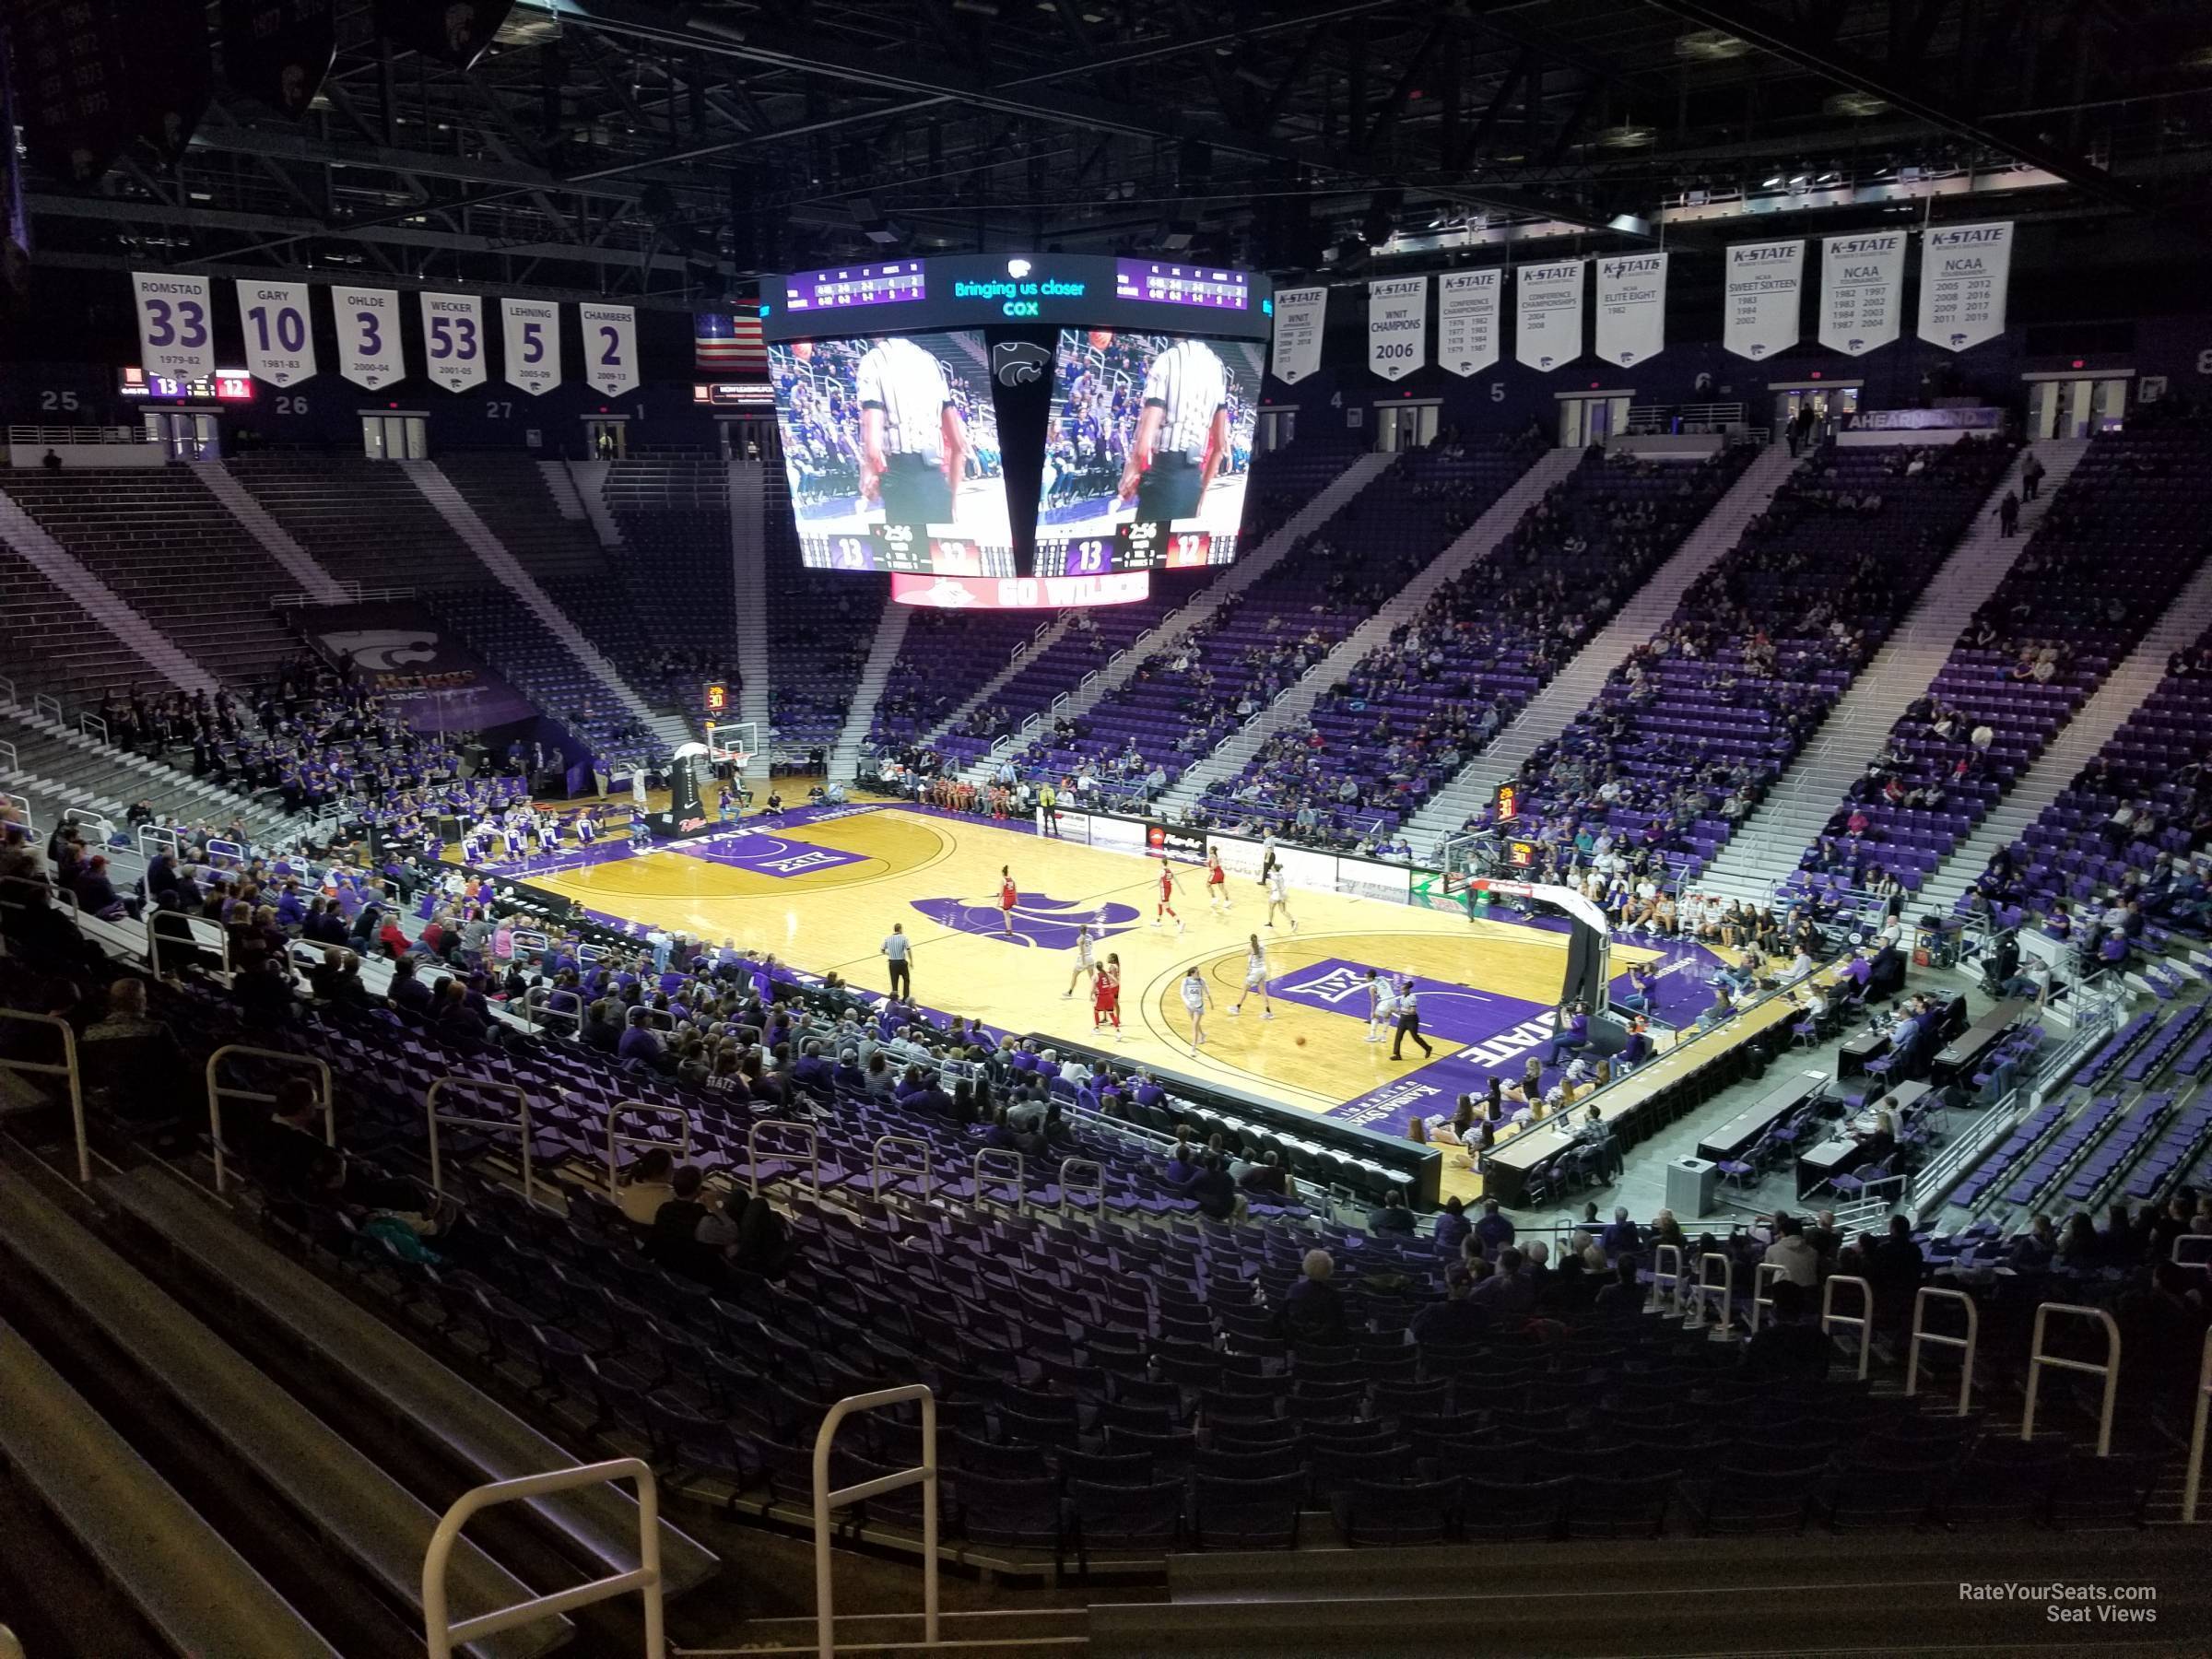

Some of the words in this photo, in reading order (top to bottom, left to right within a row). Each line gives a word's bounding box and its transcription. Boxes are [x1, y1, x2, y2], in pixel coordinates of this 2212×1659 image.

[1931, 228, 2004, 245] K-STATE
[1830, 237, 1899, 254] K-STATE
[1734, 246, 1797, 262] K-STATE
[1604, 259, 1661, 274] K-STATE
[1945, 258, 1983, 270] NCAA
[1524, 266, 1577, 281] K-STATE
[1844, 266, 1879, 278] NCAA
[142, 282, 202, 295] ROMSTAD
[955, 280, 1016, 299] Bringing
[1019, 283, 1038, 295] us
[1041, 279, 1085, 295] closer
[1374, 282, 1421, 296] K-STATE
[1445, 275, 1495, 289] K-STATE
[1729, 281, 1759, 292] SWEET
[1761, 279, 1797, 290] SIXTEEN
[1936, 282, 1959, 291] 2005
[1967, 280, 1991, 288] 2012
[257, 290, 288, 300] GARY
[347, 296, 384, 307] OHLDE
[1278, 291, 1322, 304] K-STATE
[1529, 291, 1571, 300] CONFERENCE
[1605, 293, 1628, 302] ELITE
[1629, 290, 1656, 300] EIGHT
[1966, 291, 1990, 300] 2016
[430, 301, 472, 312] WECKER
[1443, 305, 1493, 315] CHAMPIONSHIPS
[1450, 299, 1489, 307] CONFERENCE
[1522, 298, 1576, 309] CHAMPIONSHIPS
[1934, 304, 1958, 312] 2009
[1965, 302, 1989, 311] 2017
[510, 307, 552, 318] LEHNING
[583, 311, 632, 322] CHAMBERS
[1385, 310, 1407, 319] WNIT
[1933, 315, 1955, 324] 2011
[1964, 313, 1988, 322] 2019
[145, 300, 207, 347] 33
[248, 306, 305, 352] 10
[1371, 319, 1420, 332] CHAMPIONS
[356, 312, 382, 356] 3
[430, 317, 477, 359] 53
[524, 323, 544, 363] 5
[600, 326, 621, 365] 2
[1375, 344, 1413, 359] 2006
[159, 355, 201, 365] 1979-82
[262, 359, 300, 369] 1981-83
[354, 363, 389, 371] 2000-04
[520, 371, 550, 379] 2005-09
[158, 378, 178, 394] 13
[224, 379, 243, 395] 12
[1490, 382, 1506, 402] 5
[41, 391, 79, 411] 25
[276, 396, 308, 415] 26
[1330, 392, 1342, 408] 4
[487, 402, 512, 418] 27
[1849, 414, 1925, 429] AHEARN
[1128, 523, 1157, 540] 2:56
[839, 538, 863, 567] 13
[1079, 540, 1102, 571] 13
[1178, 535, 1200, 565] 12
[998, 579, 1038, 606] GO
[1498, 798, 1512, 819] 30
[630, 825, 776, 855] K-STATE
[706, 1076, 737, 1092] STATE
[1377, 1085, 1443, 1112] KANSAS
